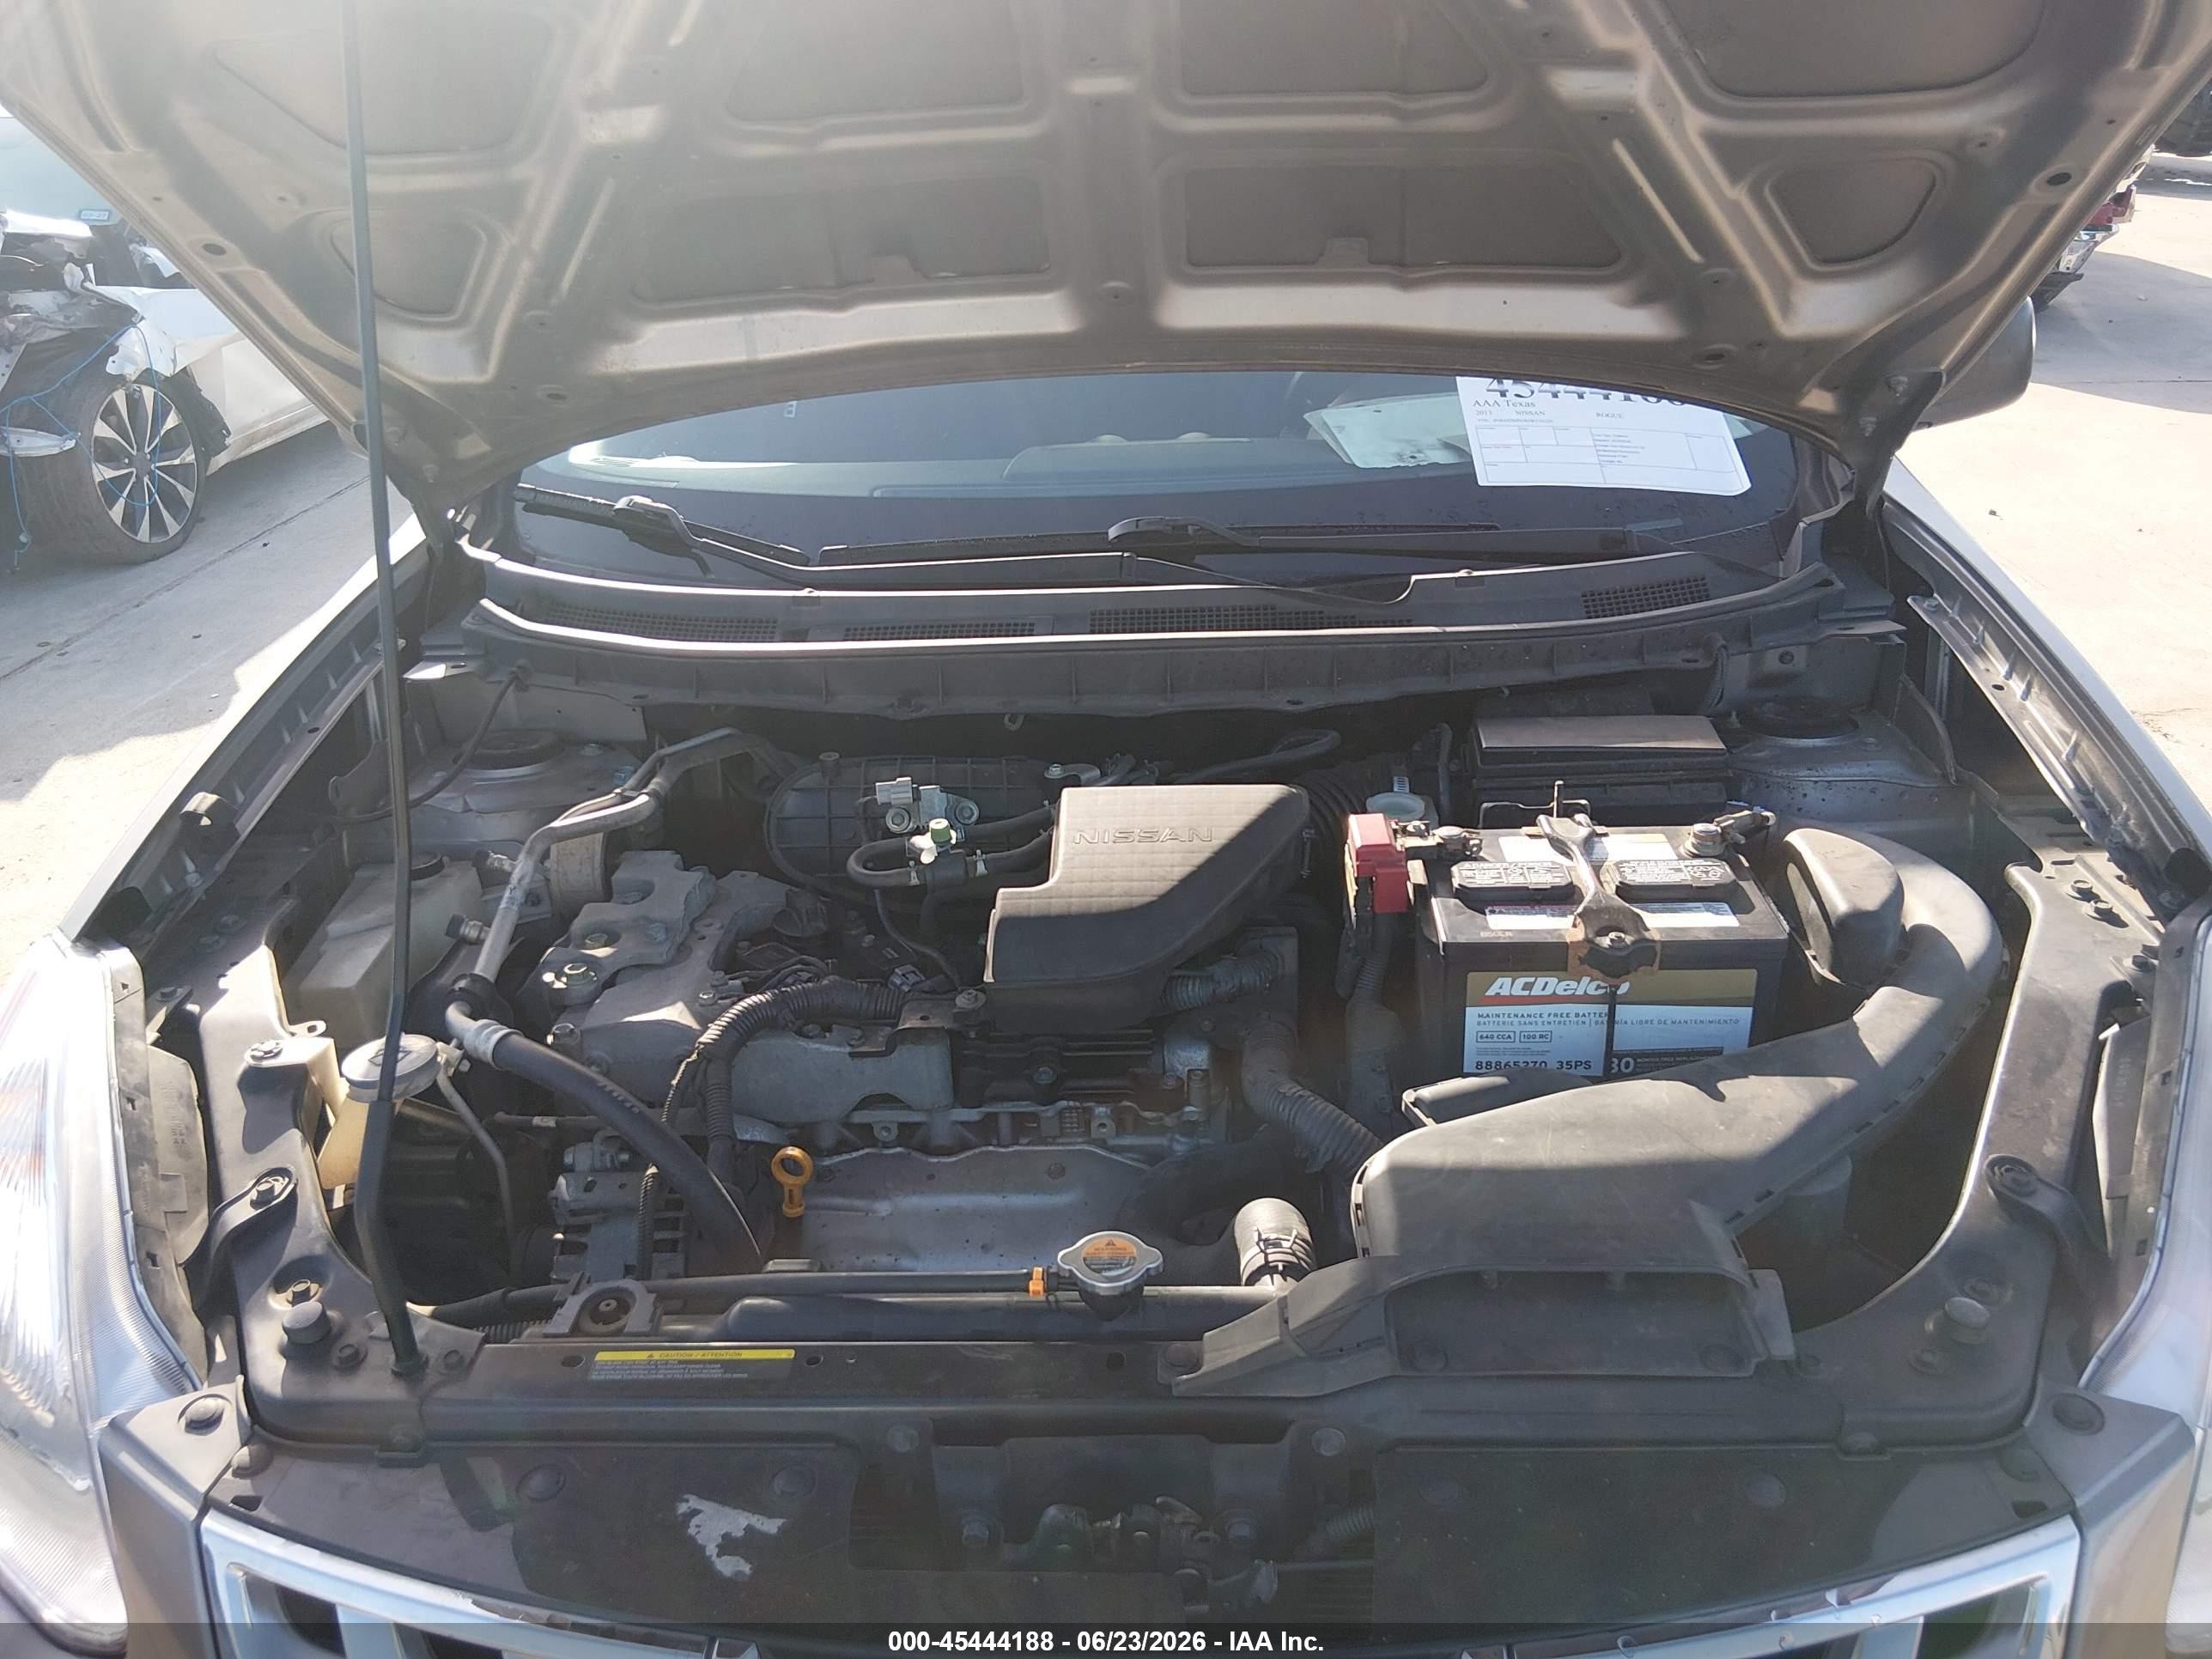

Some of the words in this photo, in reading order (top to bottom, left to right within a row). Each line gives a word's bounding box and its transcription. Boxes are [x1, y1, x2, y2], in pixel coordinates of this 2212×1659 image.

[1473, 399, 1500, 408] AAA
[1504, 399, 1536, 408] Texas
[1073, 827, 1214, 844] NISSAN
[1556, 1060, 1592, 1070] 35PS
